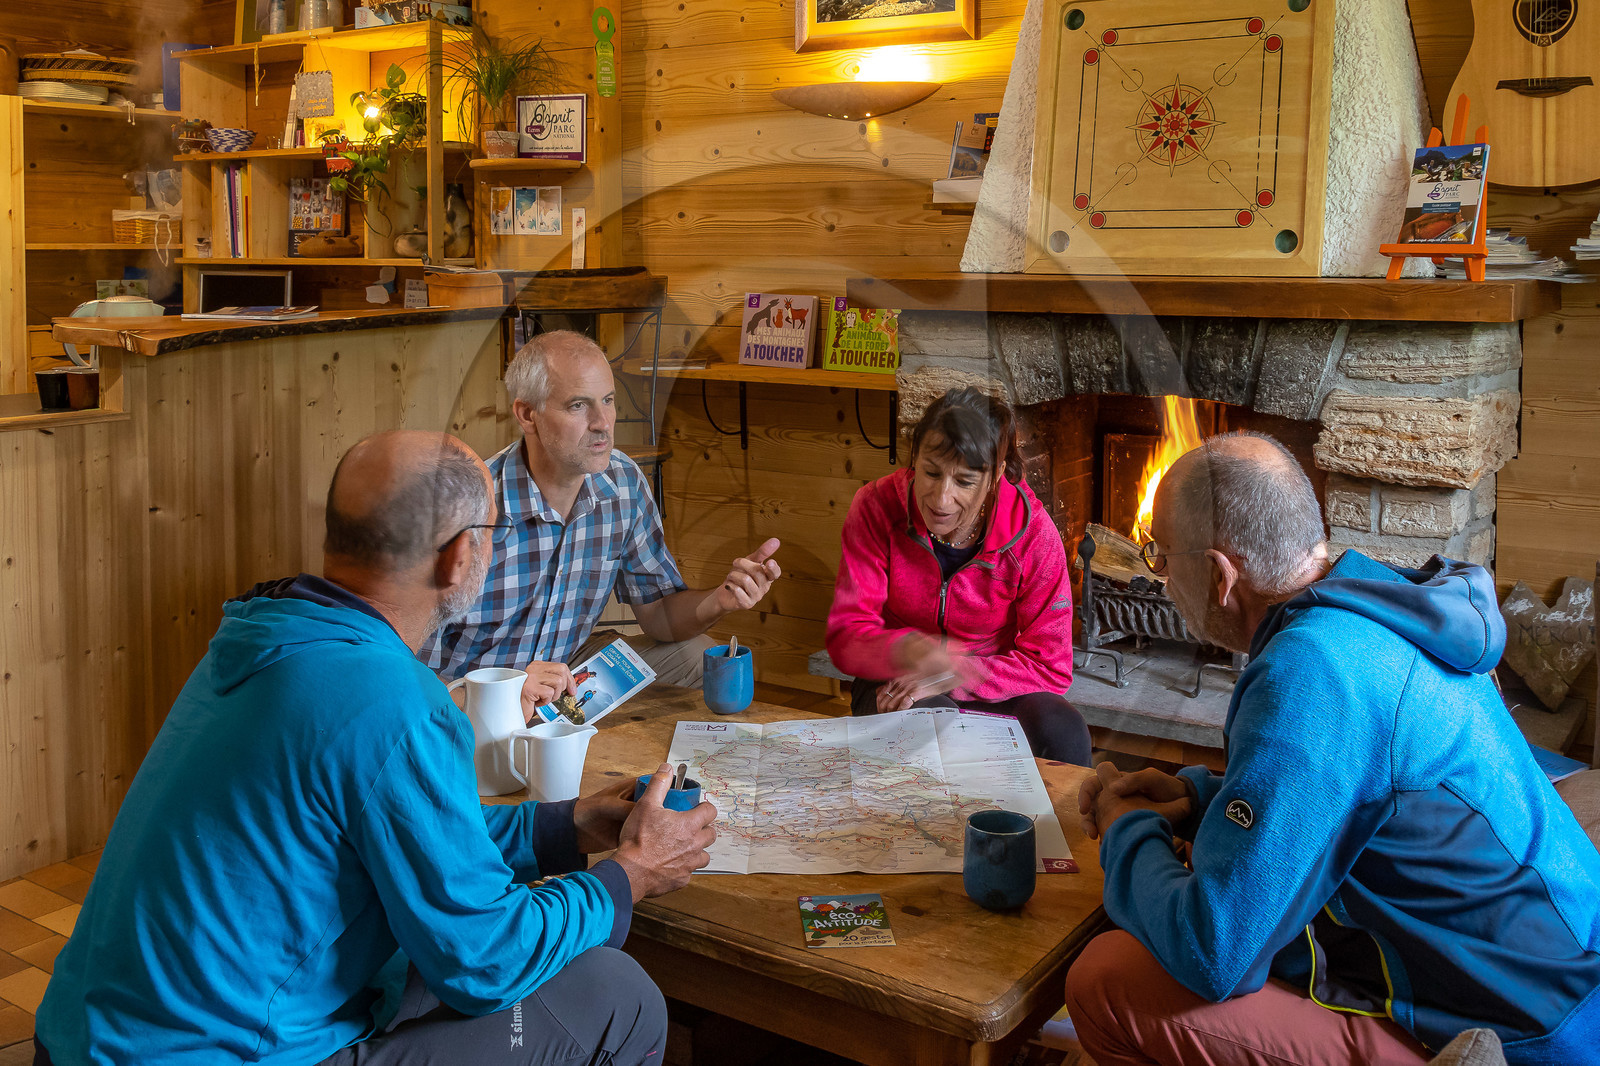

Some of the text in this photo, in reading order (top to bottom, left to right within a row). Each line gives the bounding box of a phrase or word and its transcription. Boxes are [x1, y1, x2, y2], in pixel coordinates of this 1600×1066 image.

[530, 103, 575, 140] Esprit
[553, 125, 575, 133] PARC
[857, 322, 873, 330] MES
[756, 327, 806, 338] MES ANIMAUX
[847, 330, 882, 340] ANIMAUX
[748, 335, 805, 347] DES MONTAGNES
[841, 339, 889, 351] DE LA FORÊT
[744, 344, 804, 363] À TOUCHER
[829, 348, 896, 368] À TOUCHER
